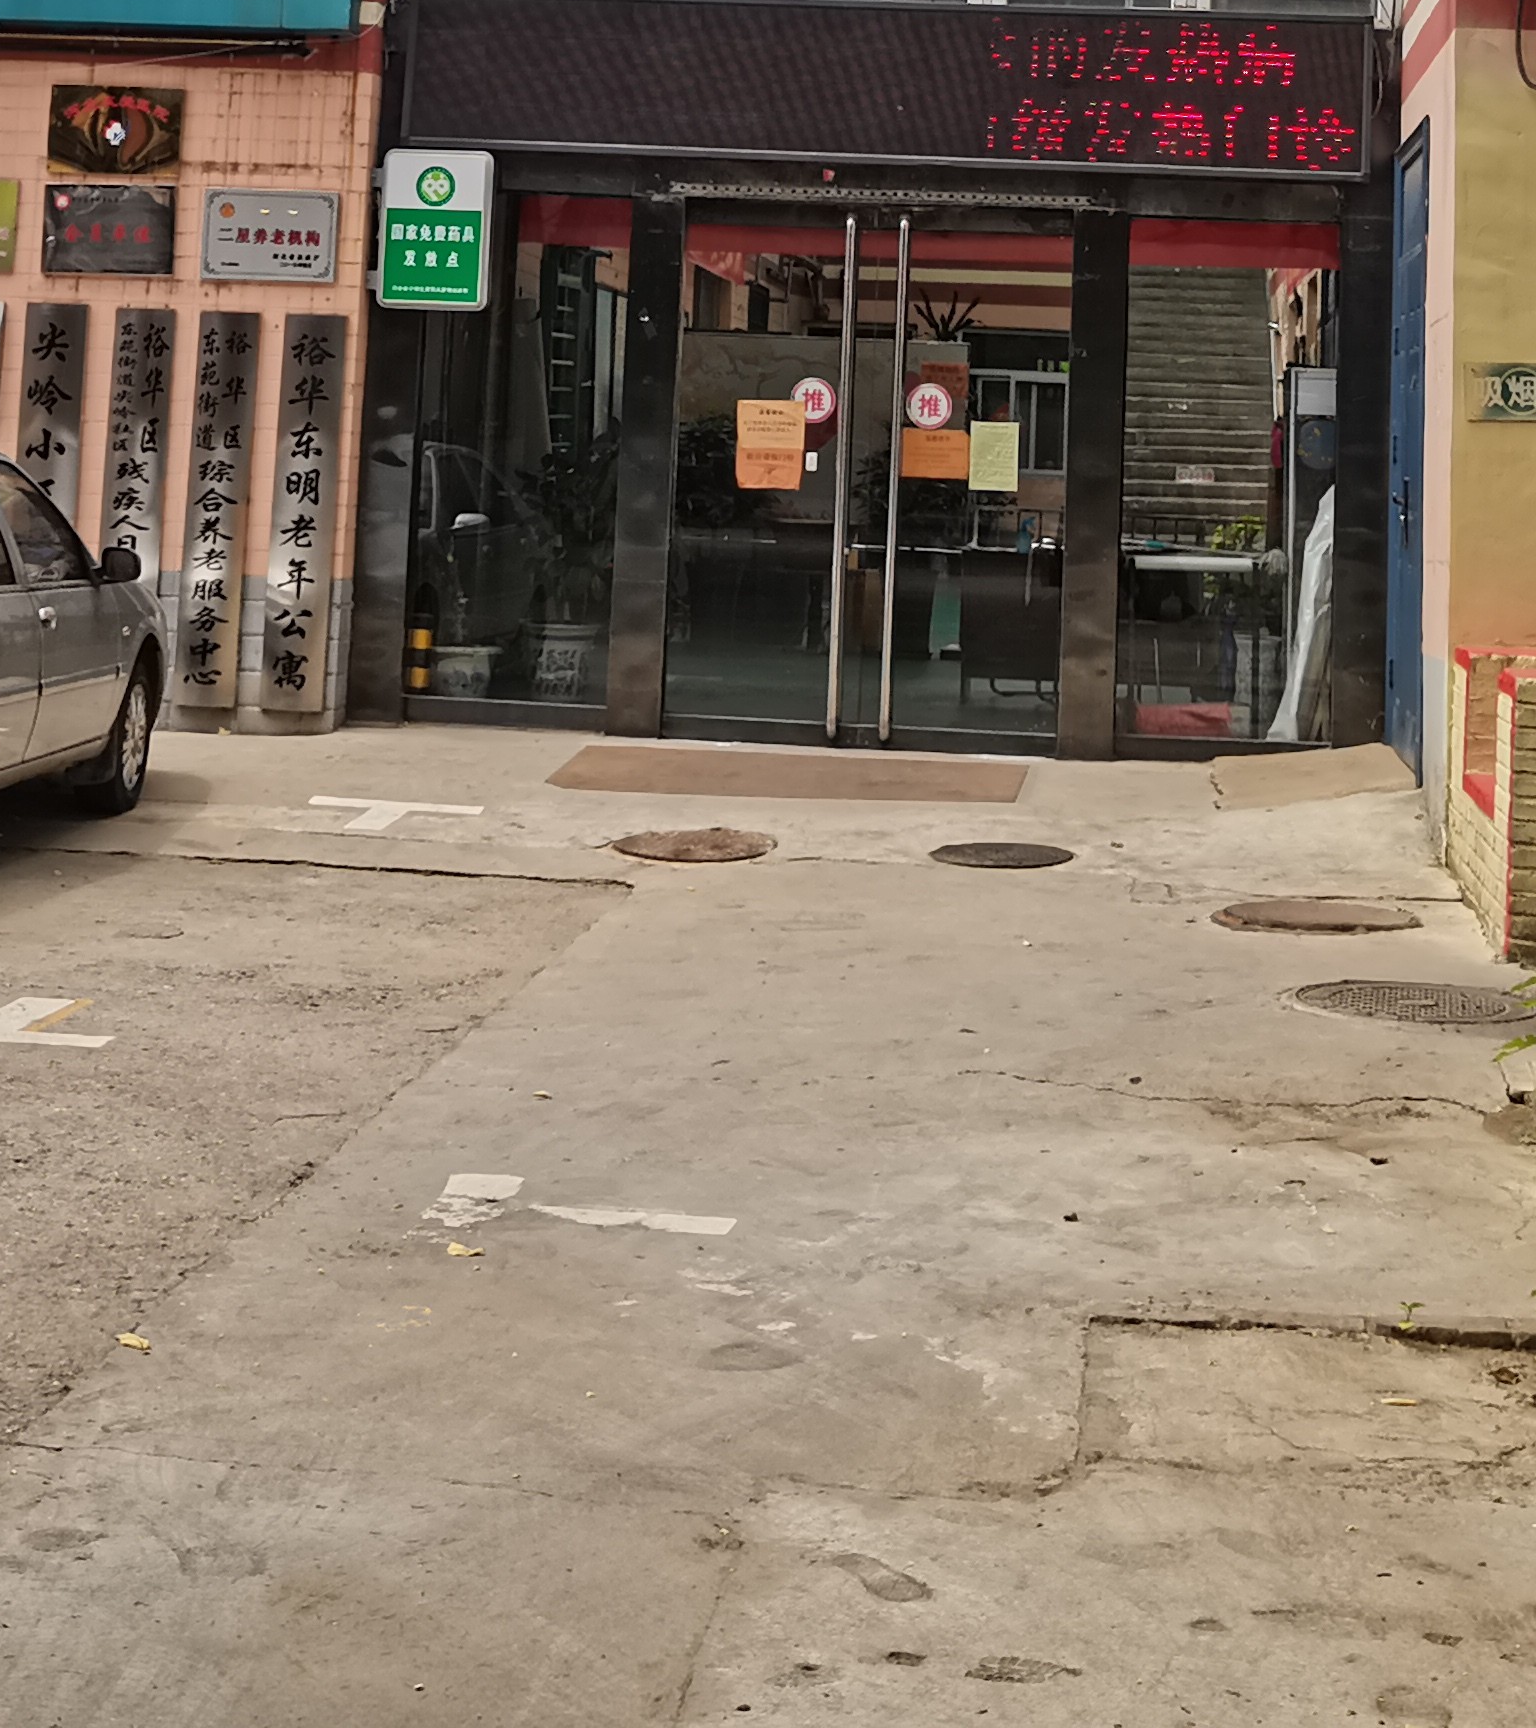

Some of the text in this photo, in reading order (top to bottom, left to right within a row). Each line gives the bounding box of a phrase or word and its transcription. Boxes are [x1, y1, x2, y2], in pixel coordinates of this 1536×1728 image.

[217, 228, 321, 246] 二星养老机构
[390, 223, 475, 243] 国家免费药具
[403, 250, 459, 268] 发放点
[801, 388, 825, 413] 推
[917, 393, 942, 419] 推
[271, 332, 337, 691] 裕华东明老年公寓
[183, 459, 238, 687] 综合养老服务中心
